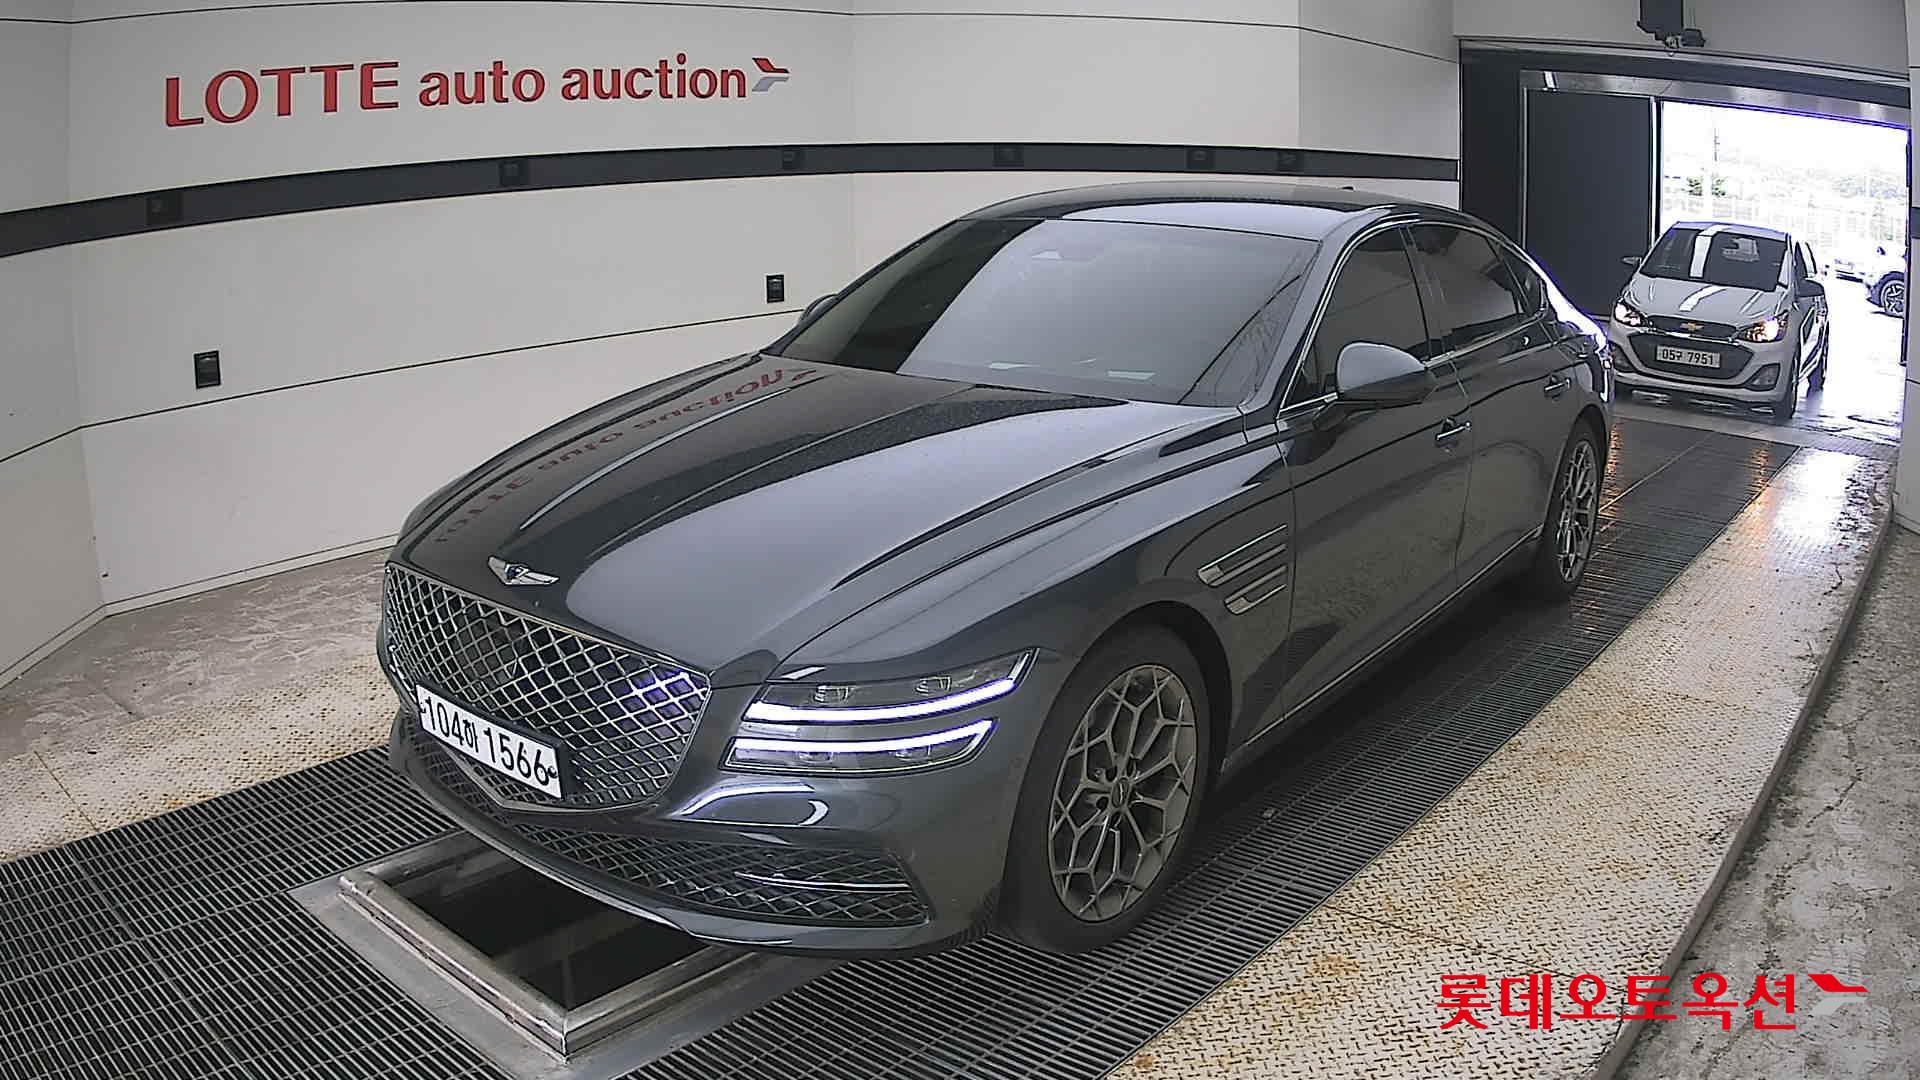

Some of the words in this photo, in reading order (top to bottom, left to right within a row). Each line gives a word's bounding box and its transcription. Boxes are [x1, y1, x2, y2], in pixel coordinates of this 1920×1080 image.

[165, 61, 400, 127] LOTTE
[418, 60, 546, 107] auto
[561, 52, 748, 100] auction
[1687, 351, 1714, 366] 7951
[484, 726, 550, 786] 1566
